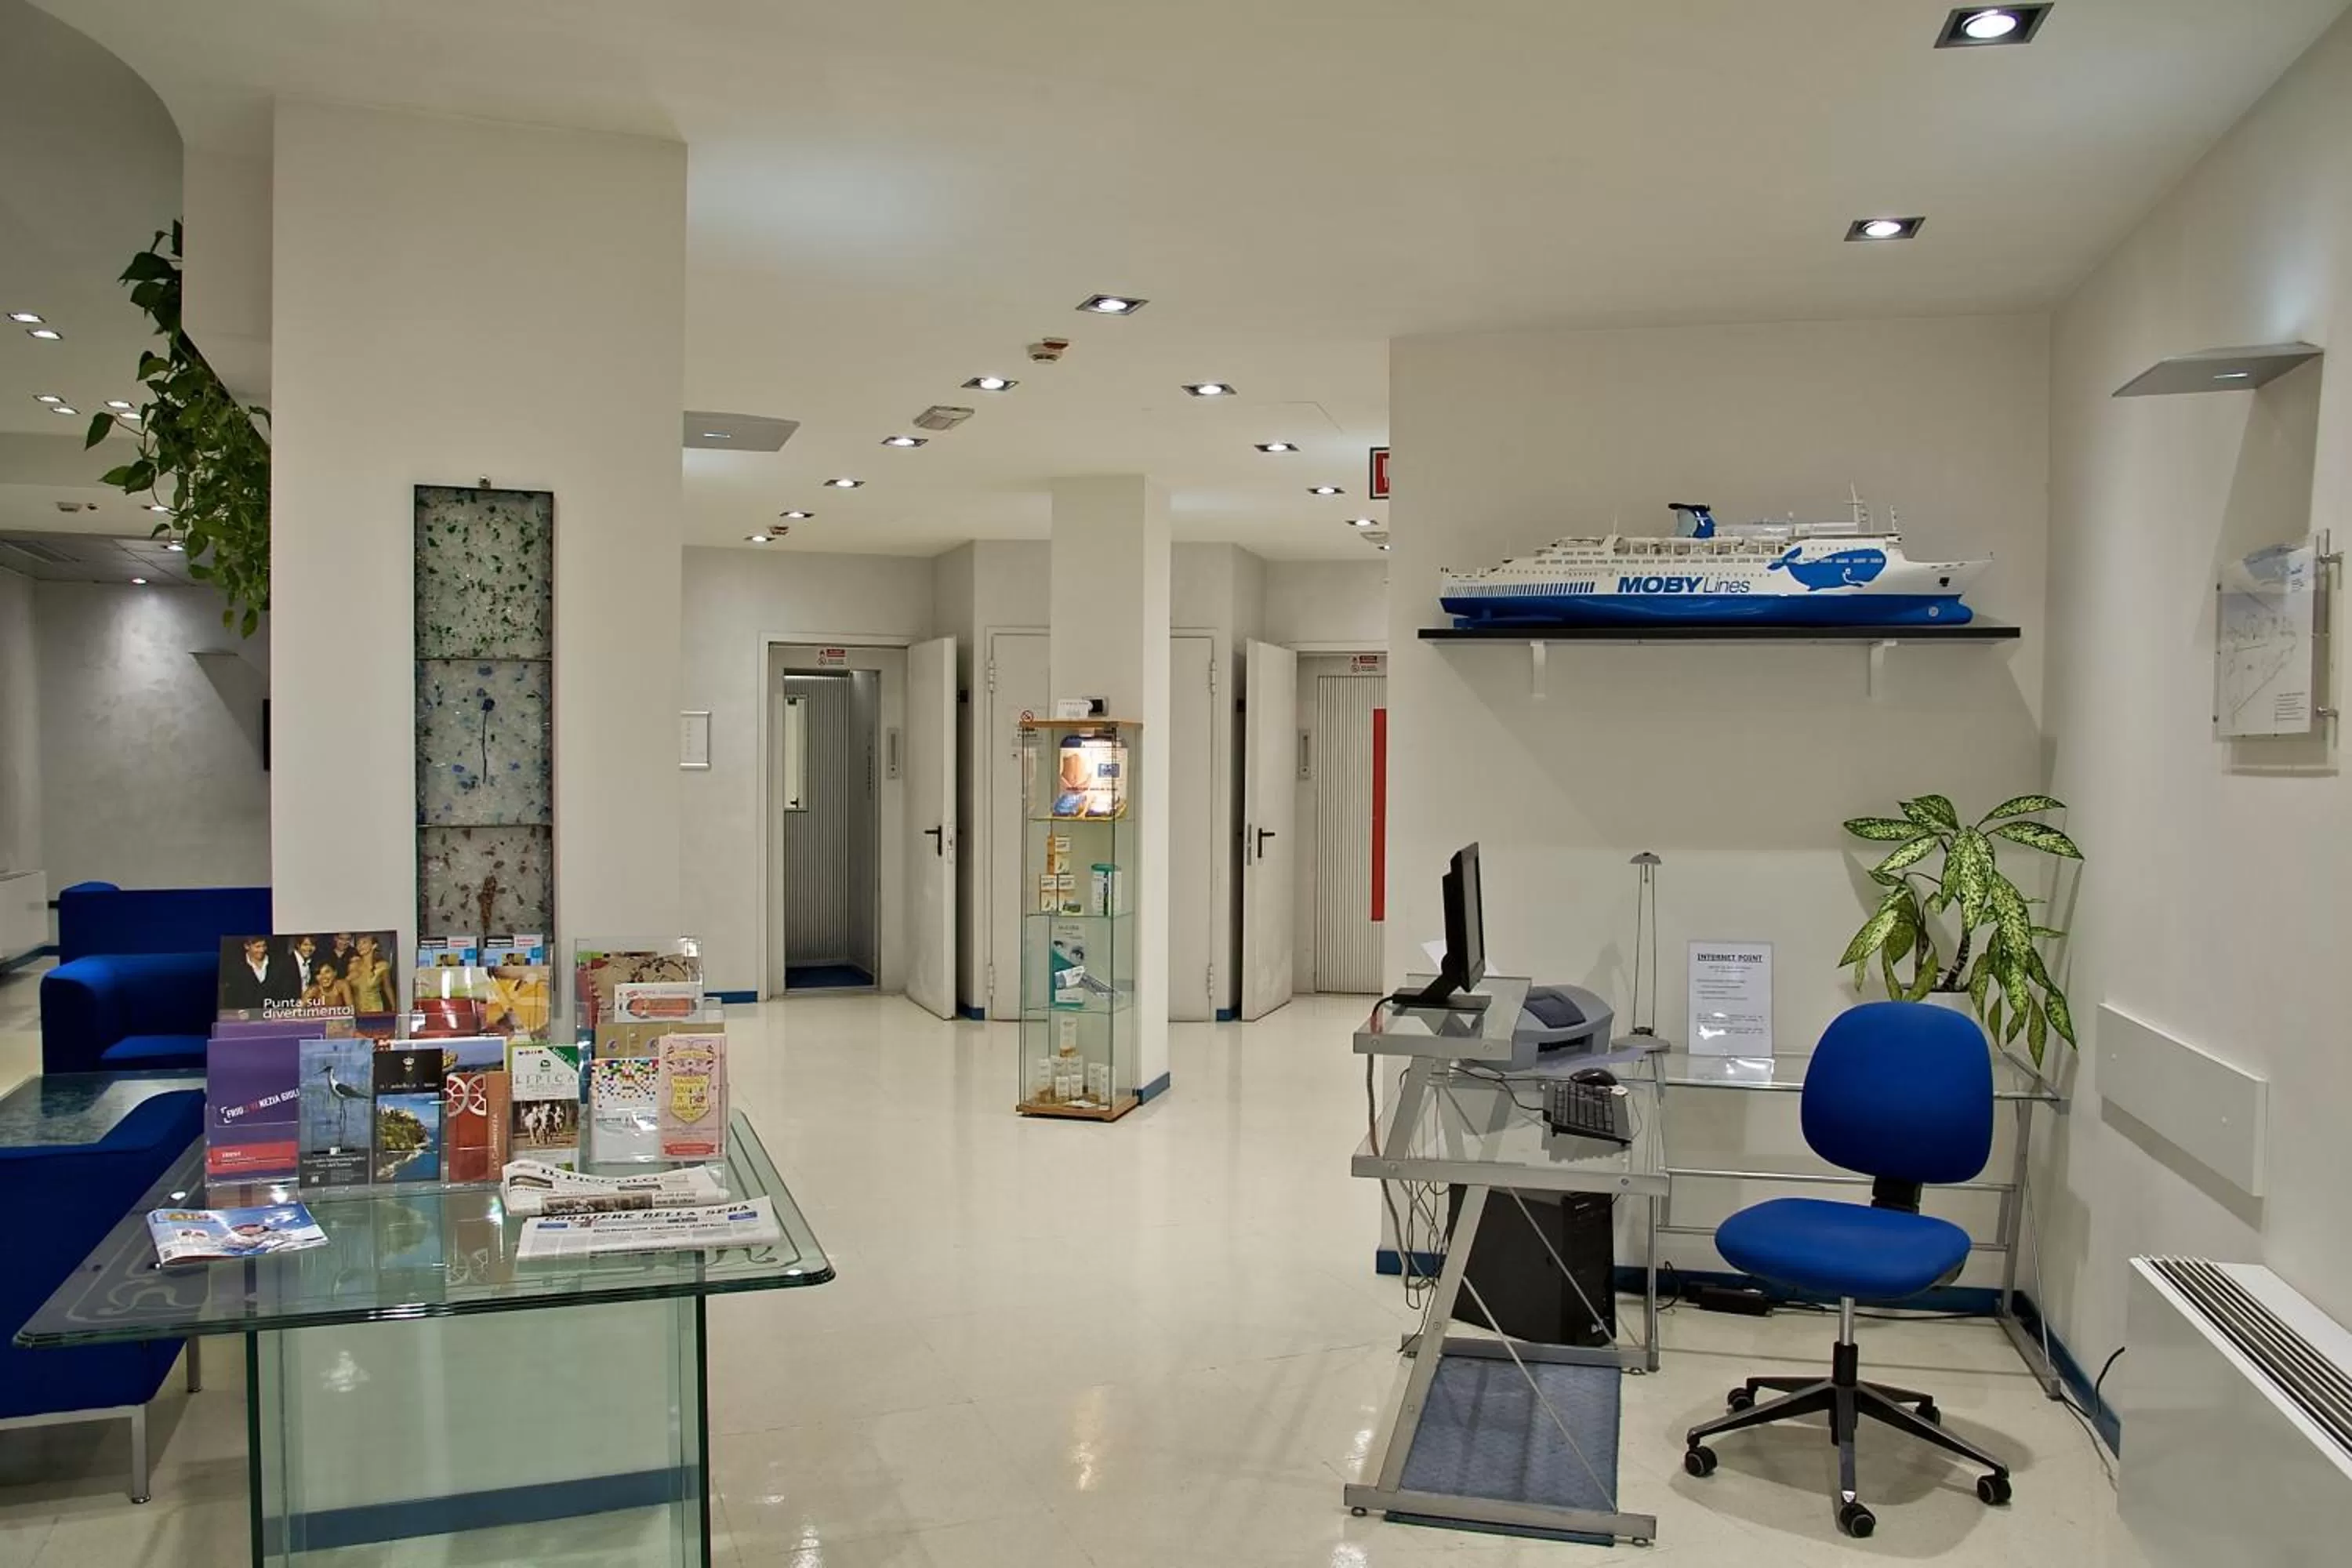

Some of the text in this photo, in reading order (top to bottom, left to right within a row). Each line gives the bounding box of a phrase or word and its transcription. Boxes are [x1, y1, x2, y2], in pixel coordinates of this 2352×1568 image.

[1617, 576, 1751, 593] MOBY Lines
[1697, 953, 1762, 963] INTERNET POINT
[263, 996, 325, 1008] Punta sul
[263, 1005, 354, 1018] divertimento!
[515, 1074, 575, 1084] LIPICA
